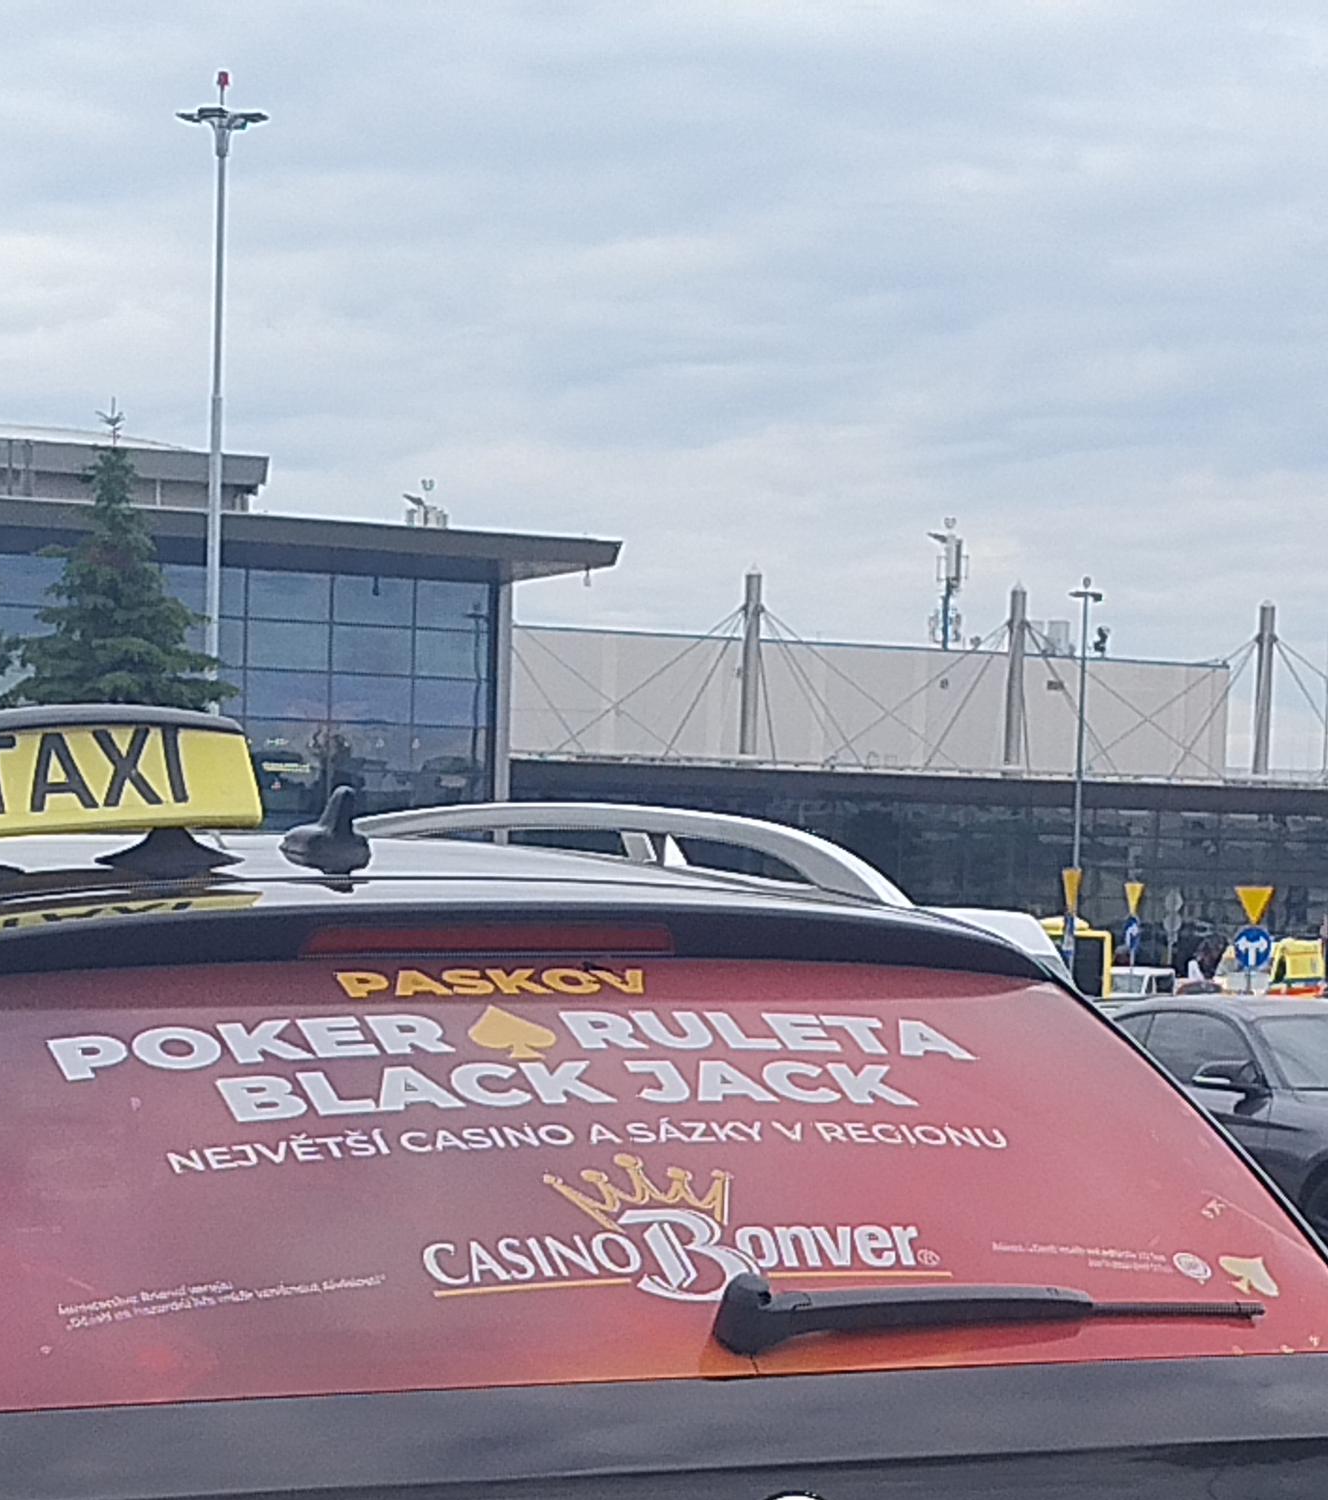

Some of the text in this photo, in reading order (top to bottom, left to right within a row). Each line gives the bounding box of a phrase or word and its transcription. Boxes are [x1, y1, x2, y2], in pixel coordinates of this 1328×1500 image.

[333, 967, 645, 999] PASKOV
[47, 1010, 980, 1081] POKER RULETA
[216, 1059, 919, 1123] BLACK JACK
[167, 1117, 1008, 1175] NEJVĚTŠÍ CASINO A SÁZKY V REGIONU
[422, 1232, 640, 1286] CASINO
